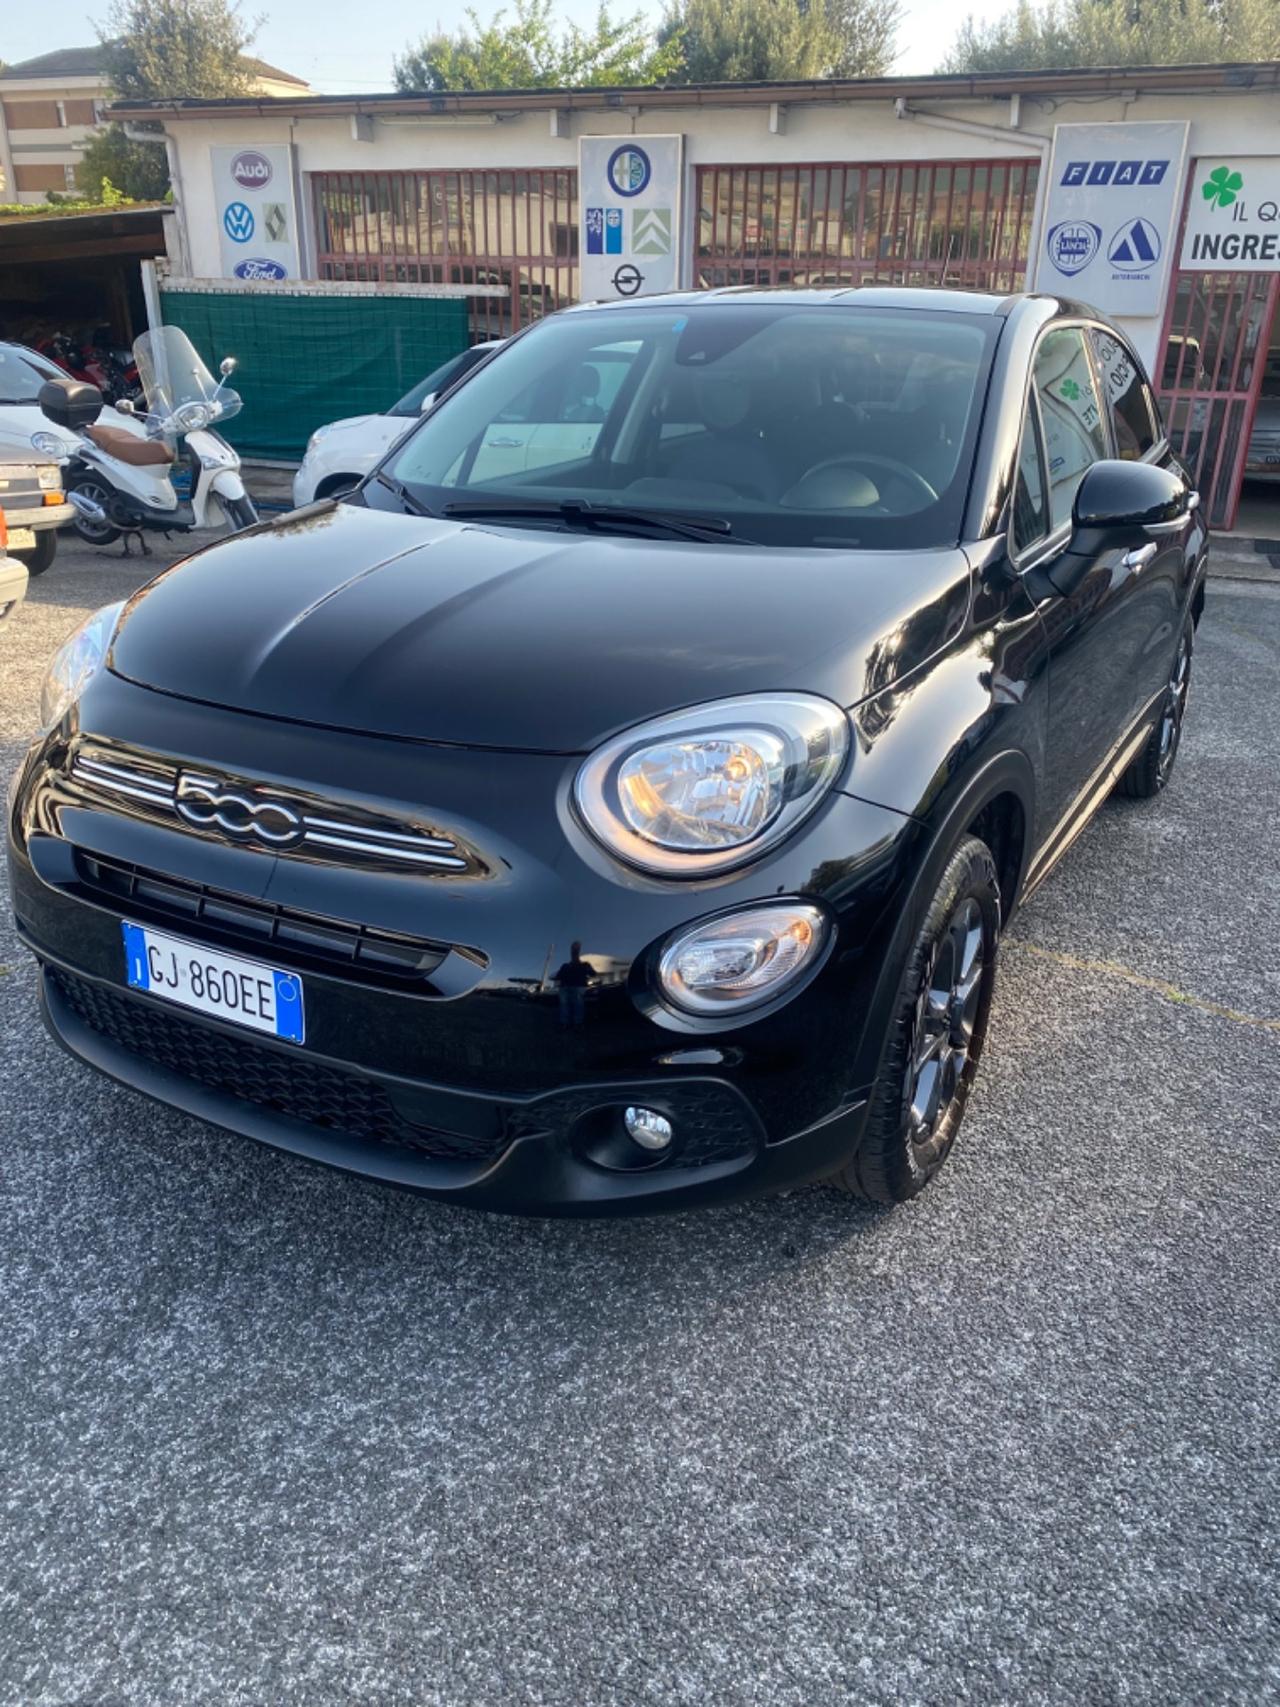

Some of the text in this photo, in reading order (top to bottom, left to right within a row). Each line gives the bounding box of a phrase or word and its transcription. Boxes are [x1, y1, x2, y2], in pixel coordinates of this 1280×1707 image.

[235, 161, 269, 178] Audi
[1065, 163, 1165, 183] FIAT
[1232, 201, 1280, 222] IL Q
[1191, 233, 1280, 260] INGRE
[243, 262, 278, 280] Ford
[177, 776, 299, 842] 500
[147, 945, 276, 1022] GJ 860EE
